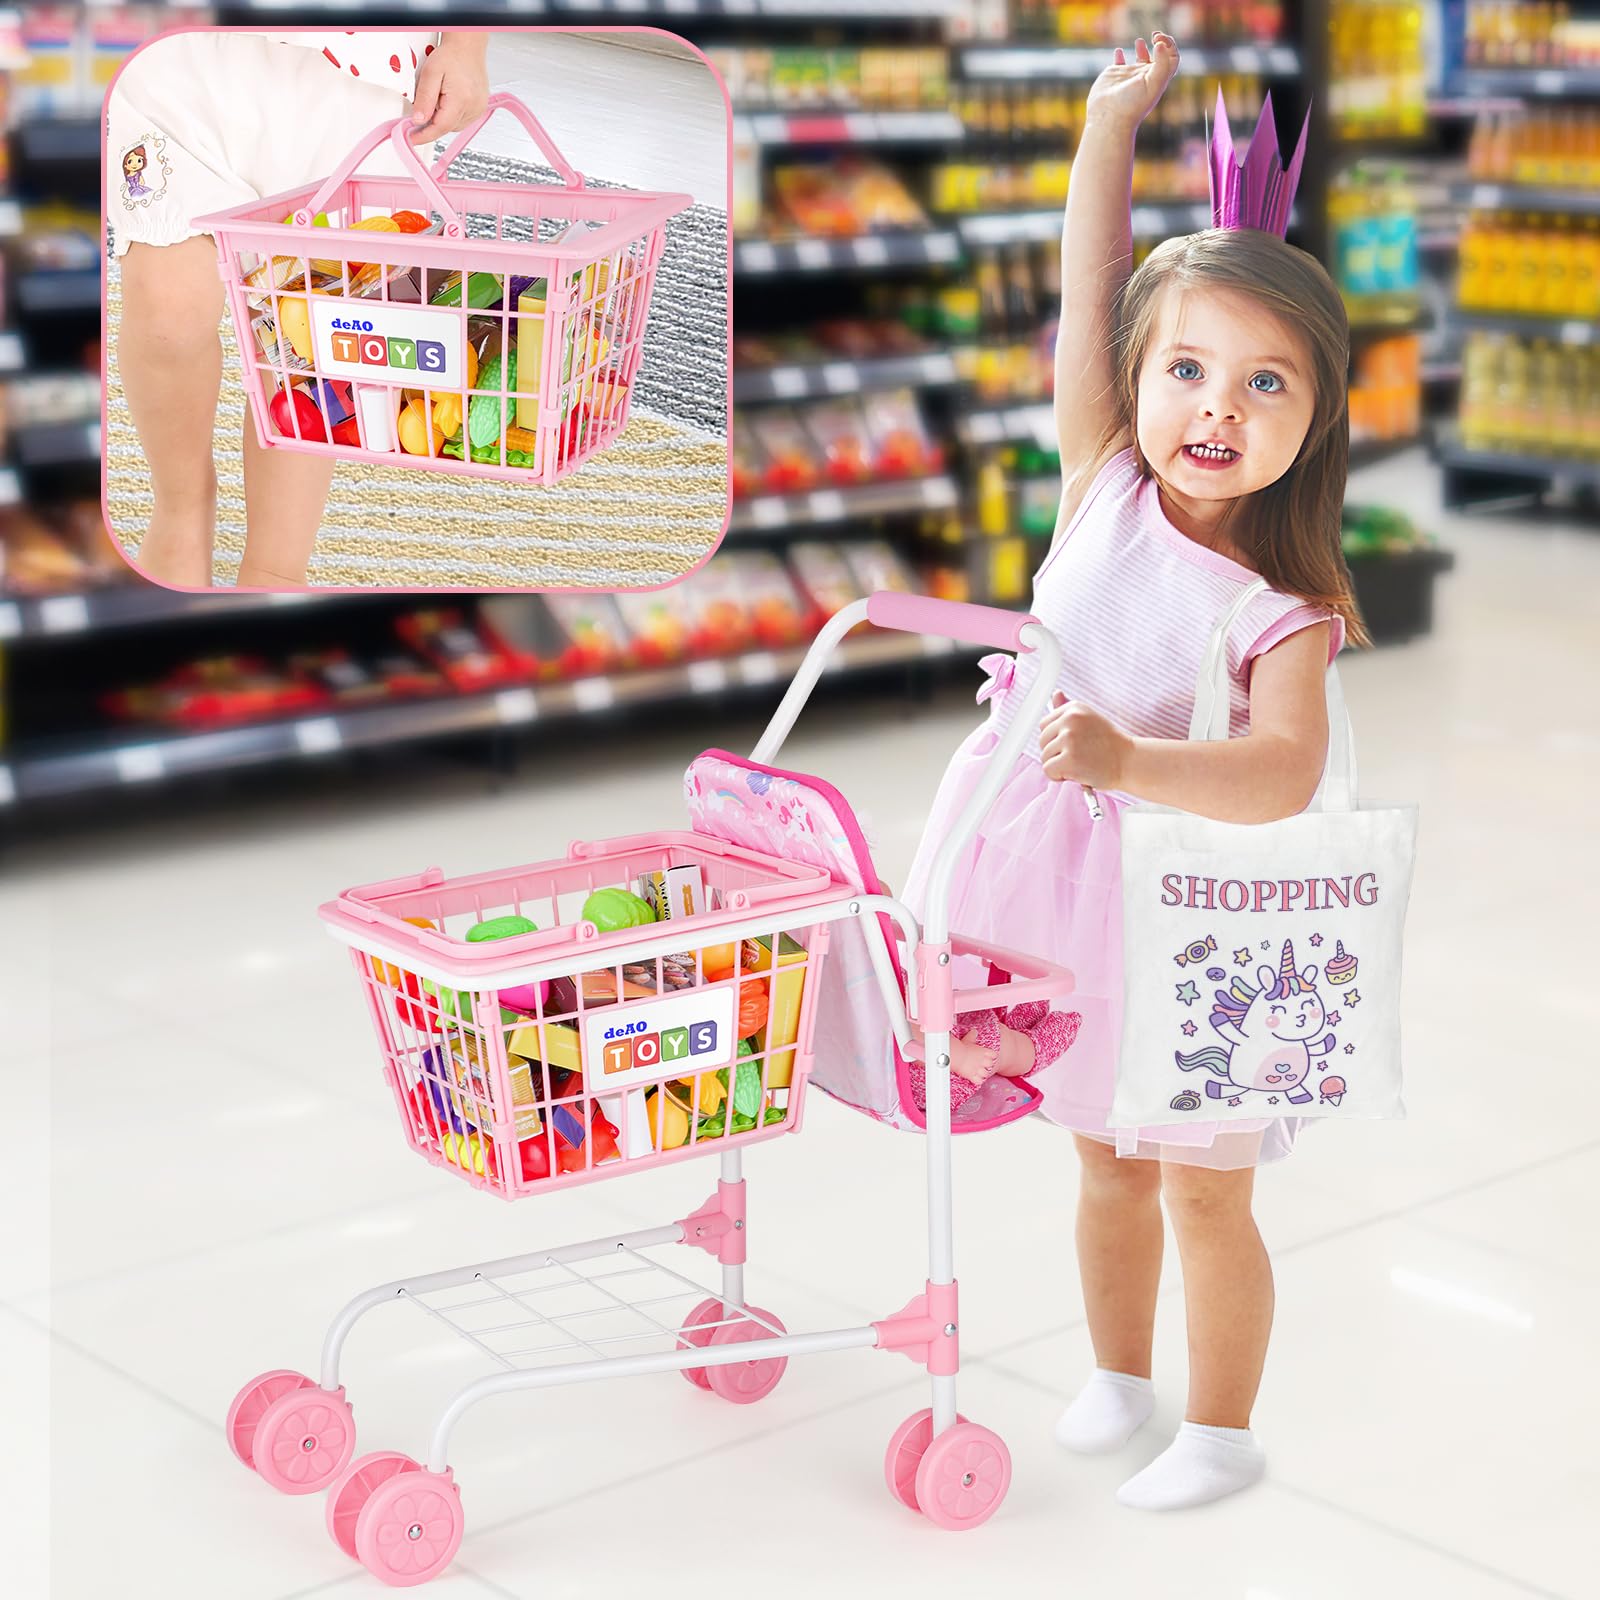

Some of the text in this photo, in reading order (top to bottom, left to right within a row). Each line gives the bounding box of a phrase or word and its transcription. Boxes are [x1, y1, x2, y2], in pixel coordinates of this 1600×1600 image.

[331, 318, 374, 332] deAO
[336, 337, 442, 369] TOYS
[1161, 872, 1379, 912] SHOPPING
[604, 1021, 648, 1039] deAO
[608, 1026, 714, 1070] TOYS
